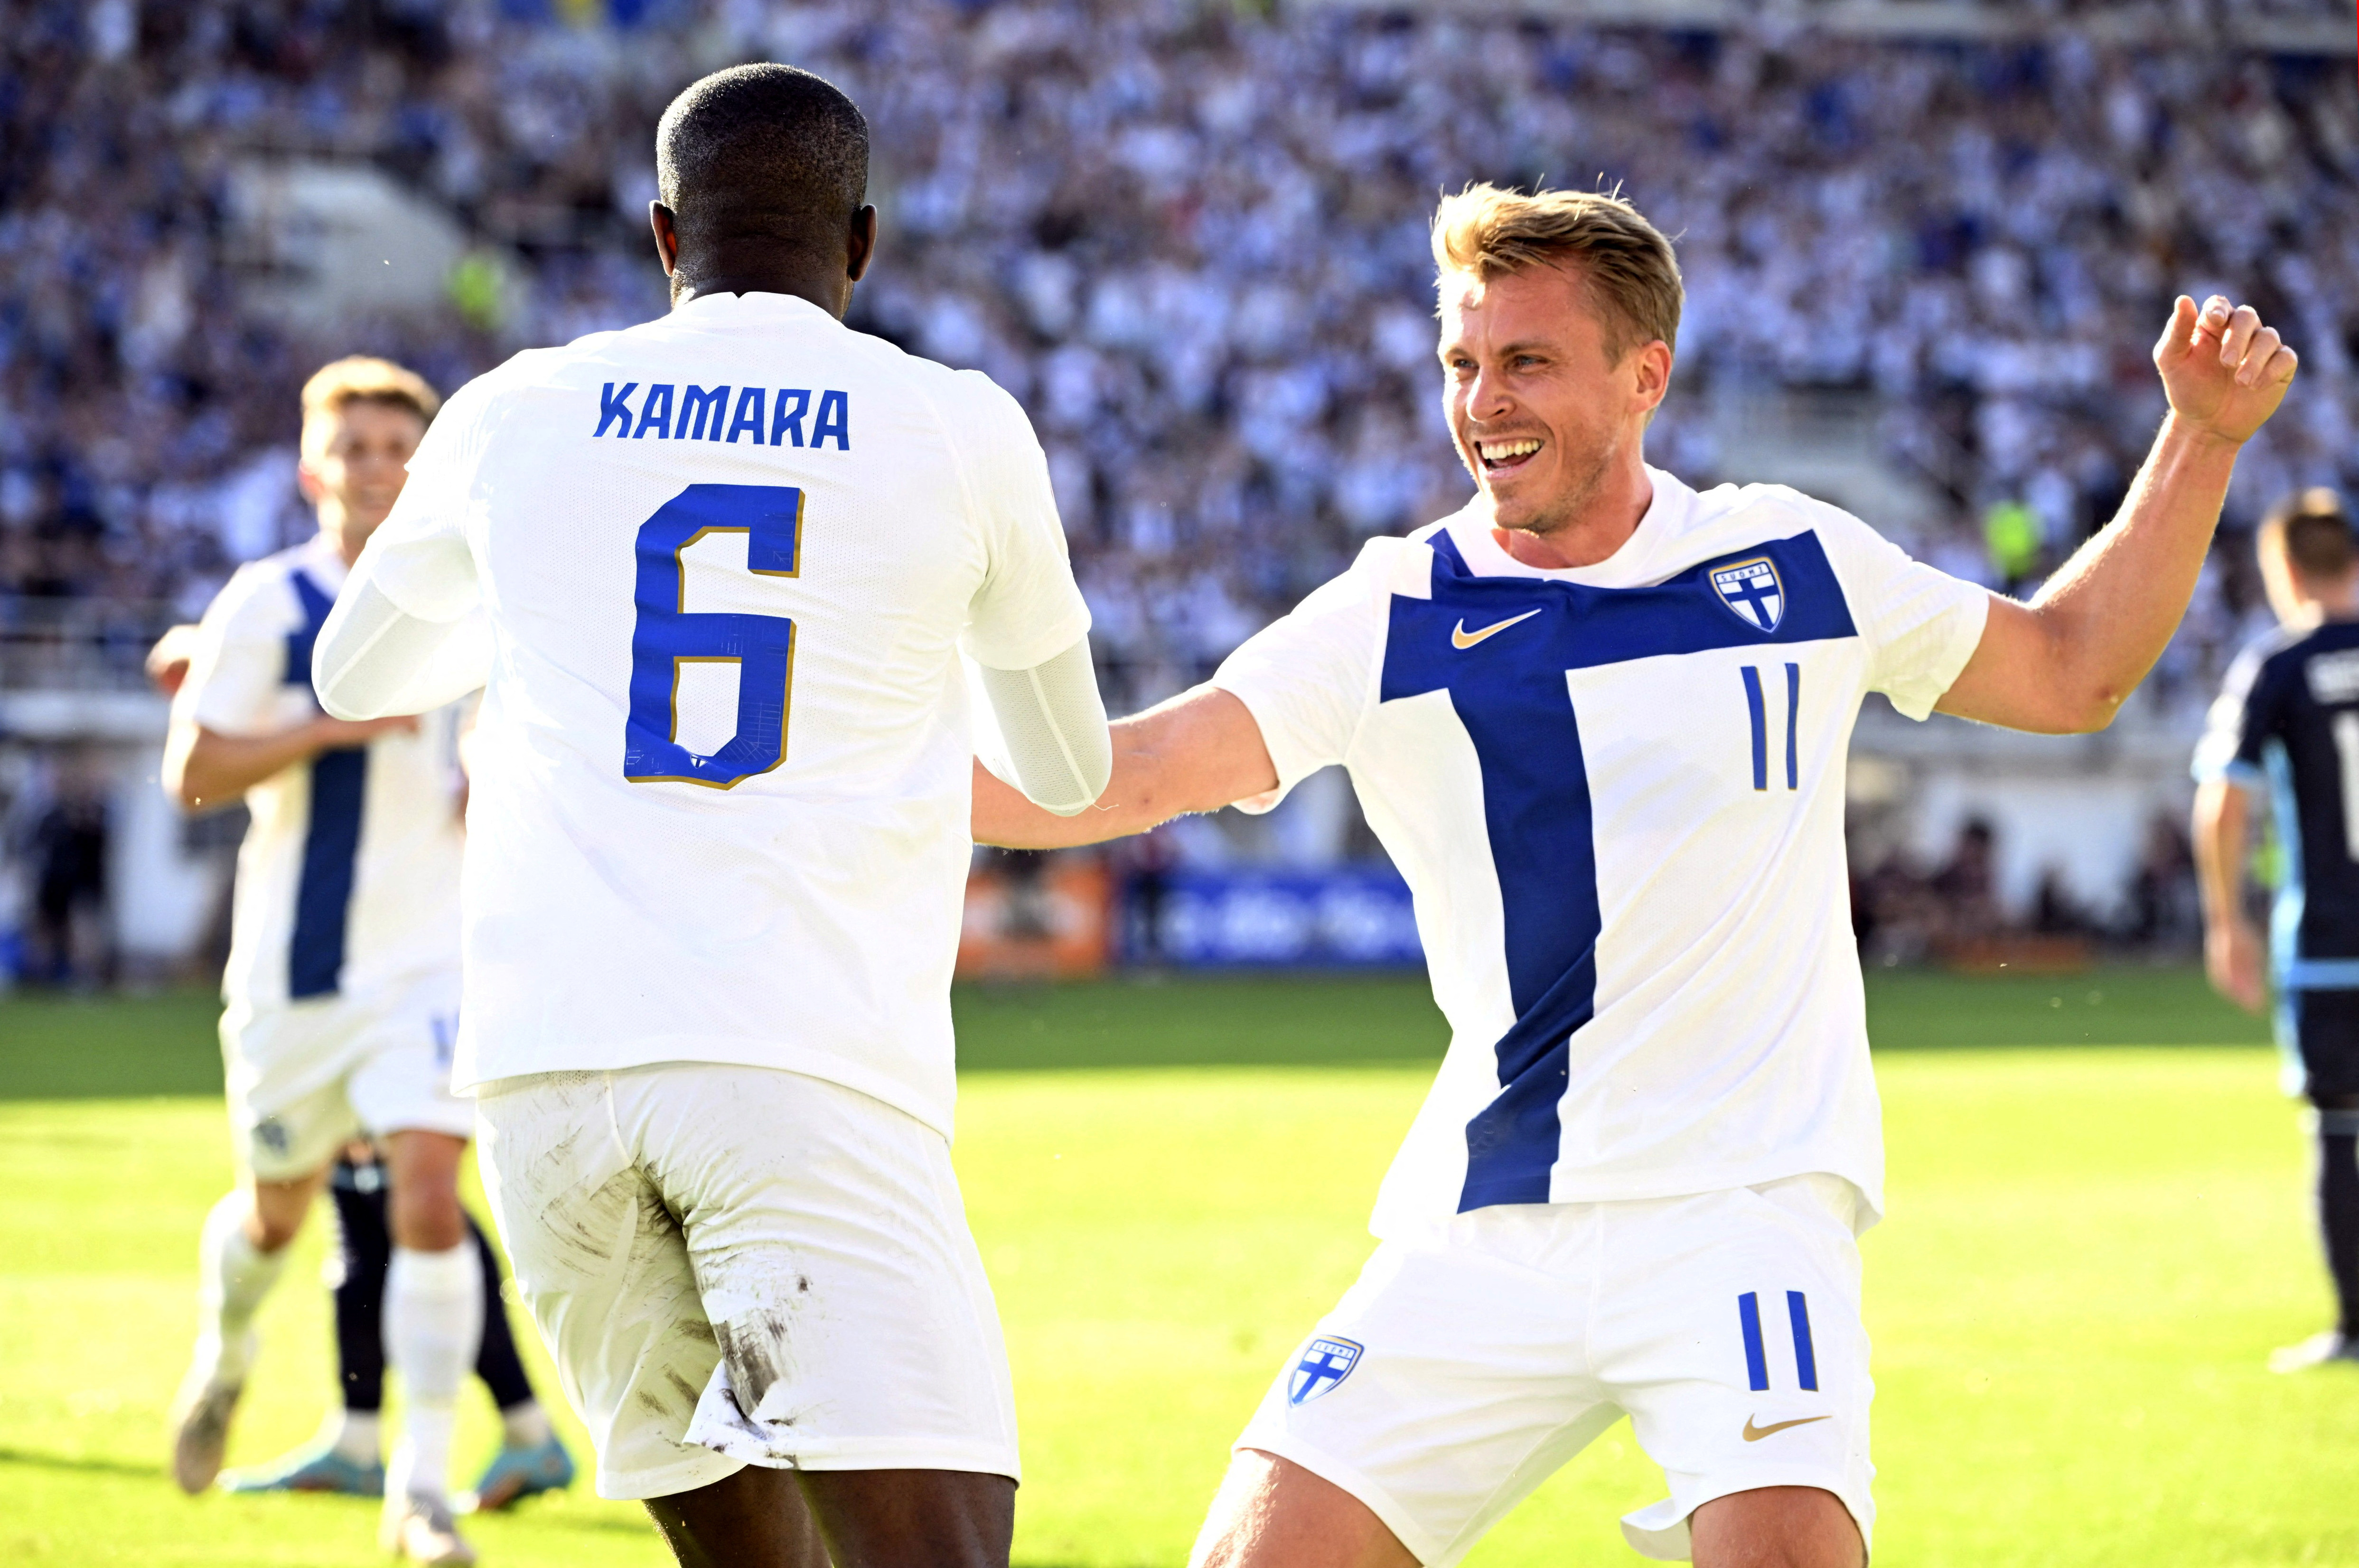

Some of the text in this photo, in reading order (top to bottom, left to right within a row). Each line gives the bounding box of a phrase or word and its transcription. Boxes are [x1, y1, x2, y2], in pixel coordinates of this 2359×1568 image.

[592, 383, 850, 450] KAMARA
[1721, 566, 1763, 582] SUOMI
[624, 484, 805, 791] 6
[1741, 663, 1799, 791] 11
[1738, 1290, 1818, 1392] 11
